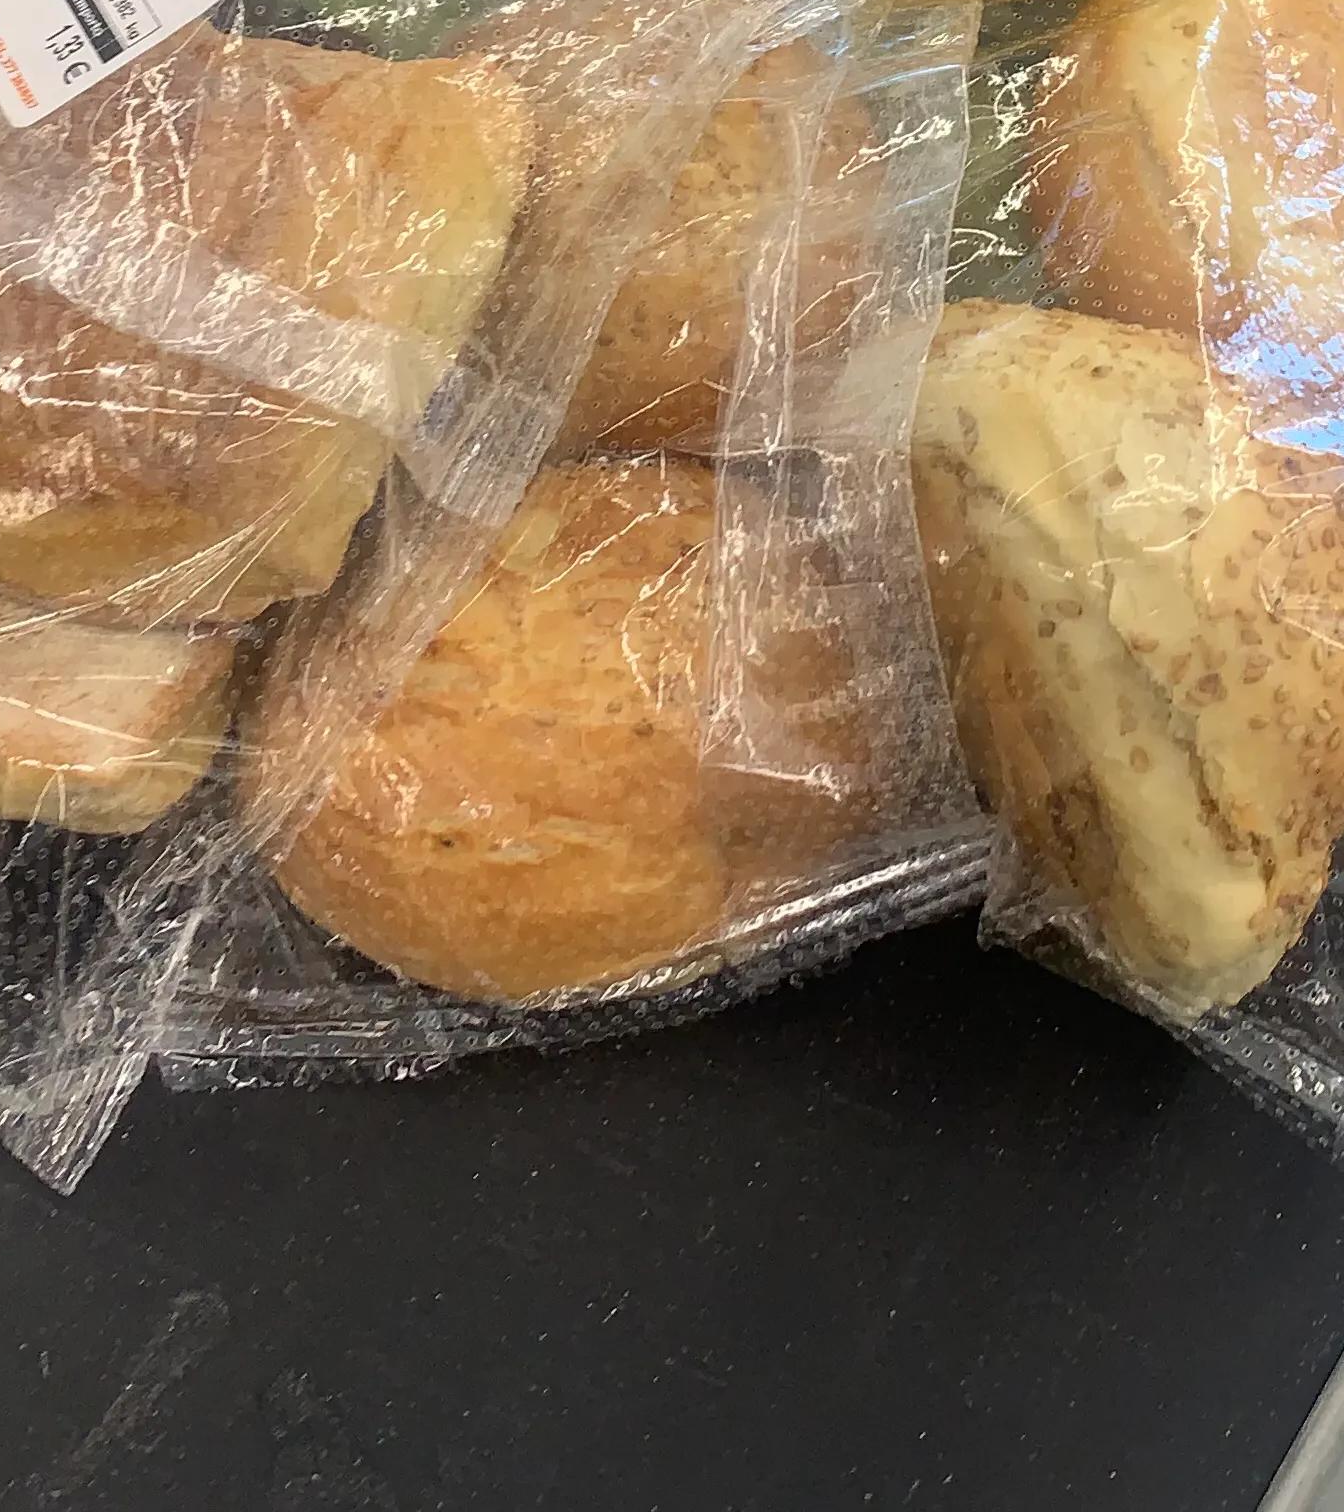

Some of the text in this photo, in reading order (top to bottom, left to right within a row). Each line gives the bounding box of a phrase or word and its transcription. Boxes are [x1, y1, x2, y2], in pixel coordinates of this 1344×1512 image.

[124, 21, 141, 41] kg
[44, 23, 91, 86] 1,33 €
